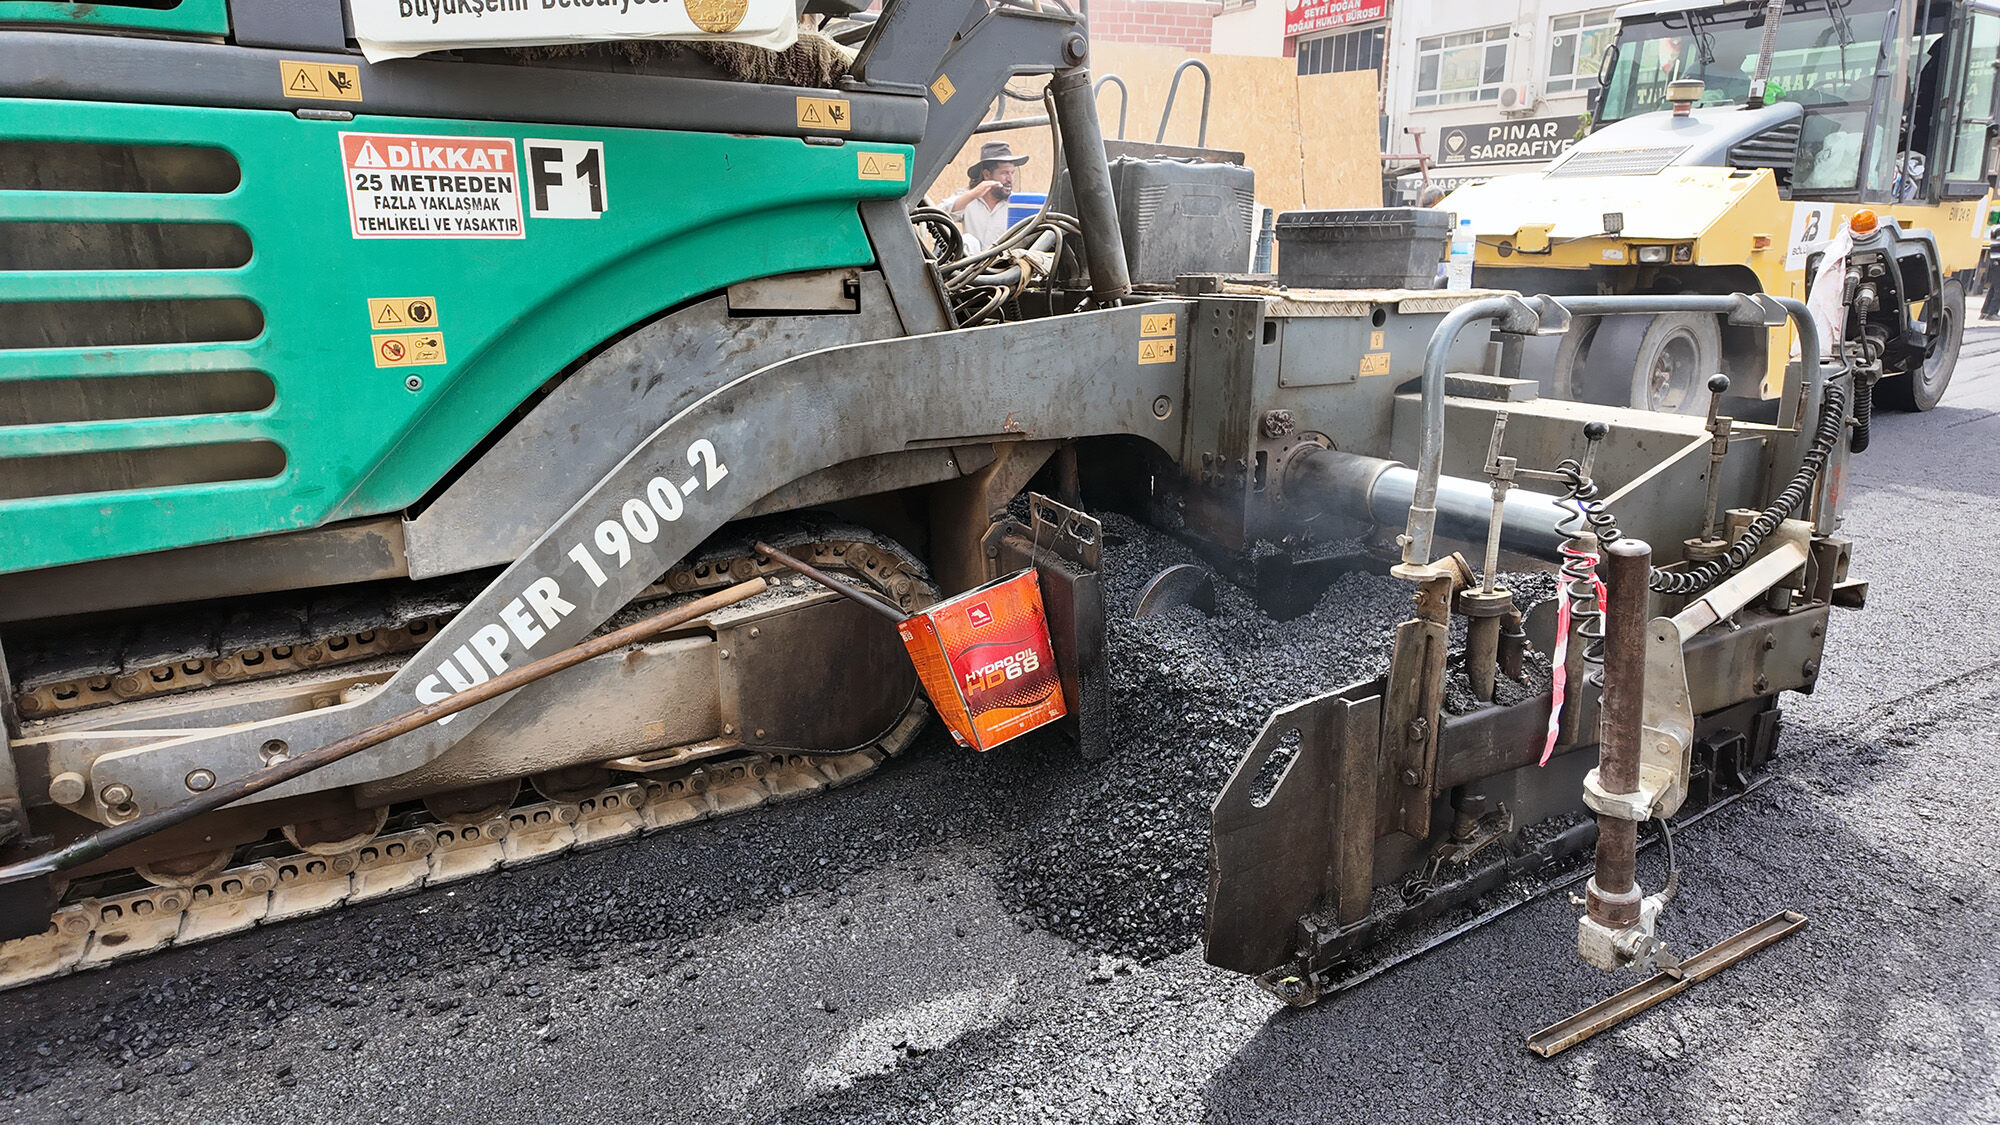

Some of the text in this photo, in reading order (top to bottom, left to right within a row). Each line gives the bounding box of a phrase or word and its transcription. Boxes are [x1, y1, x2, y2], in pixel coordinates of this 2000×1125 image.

[1287, 19, 1314, 33] DOĞAN
[1315, 14, 1345, 29] HUKUK
[1488, 122, 1559, 142] PINAR
[387, 141, 508, 170] DİKKAT
[1470, 138, 1575, 160] SARRAFİYE
[355, 174, 513, 194] 25 METREDEN
[1413, 179, 1457, 190] PNAR
[374, 196, 501, 214] FAZLA YAKLAŞMAK
[359, 214, 519, 232] TEHLİKELİ VE YASAKTIR
[415, 438, 729, 726] SUPER 1900-2
[965, 648, 1037, 683] HYDRO OIL
[966, 654, 1040, 697] HD68
